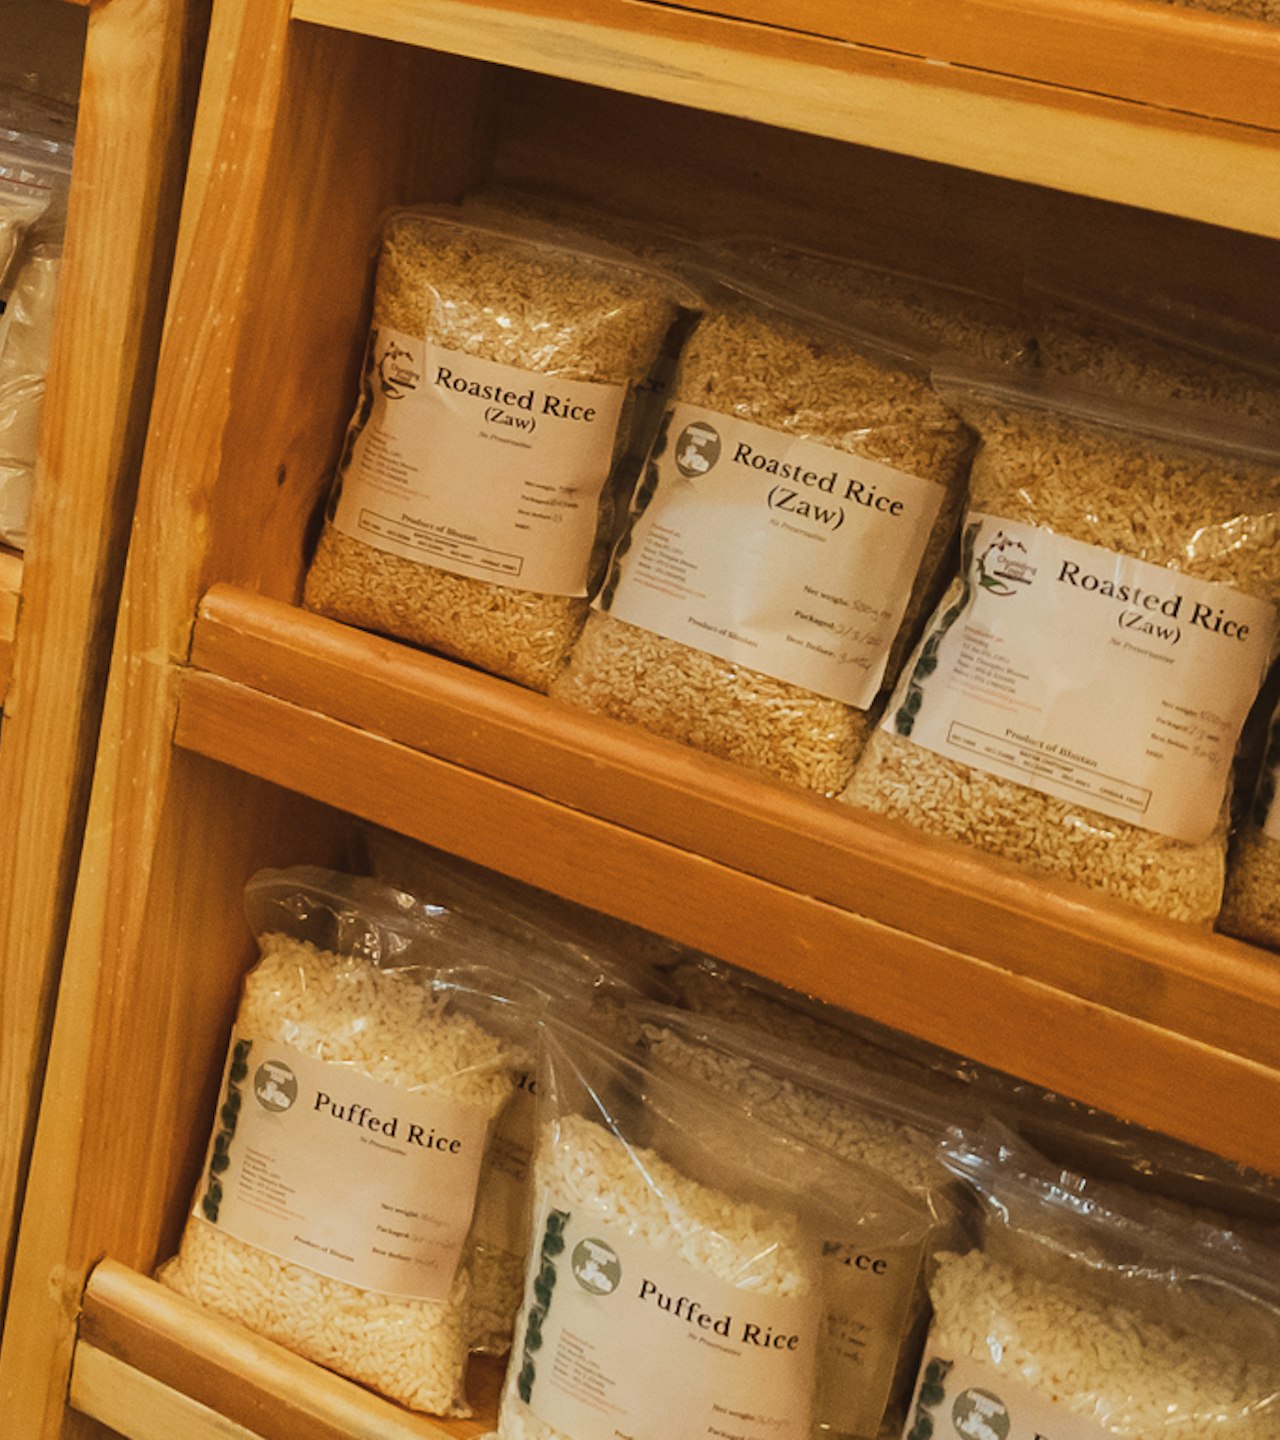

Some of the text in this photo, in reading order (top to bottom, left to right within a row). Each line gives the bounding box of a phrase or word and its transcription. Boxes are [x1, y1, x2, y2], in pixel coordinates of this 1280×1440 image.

[435, 367, 596, 423] Roasted Rice
[485, 406, 537, 434] (Zaw)
[732, 441, 904, 517] Roasted Rice
[767, 484, 845, 532] (Zaw)
[1057, 559, 1250, 642] Roasted Rice
[1118, 610, 1182, 645] (Zaw)
[1005, 728, 1045, 748] Product
[1046, 744, 1056, 755] of
[313, 1091, 463, 1155] Puffed Rice
[638, 1278, 800, 1352] Puffed Rice
